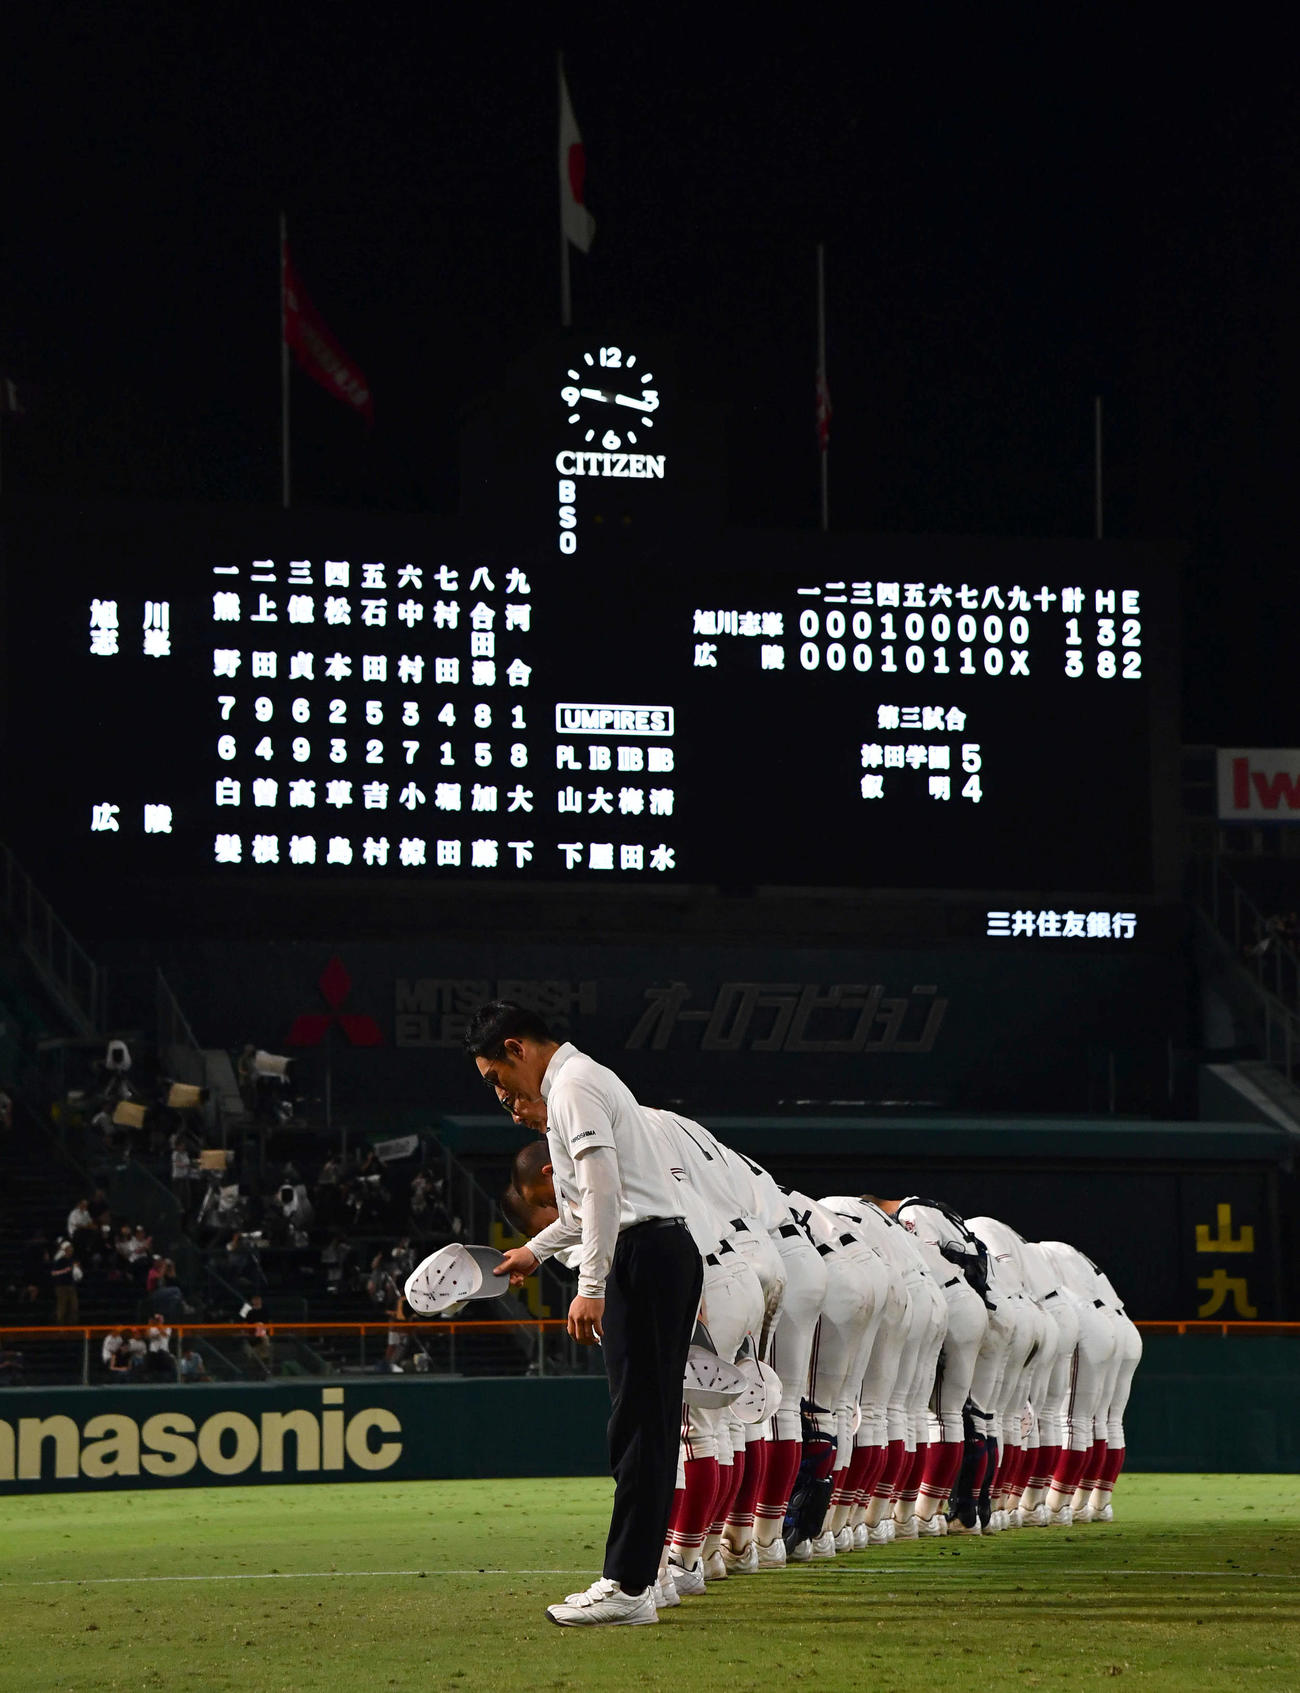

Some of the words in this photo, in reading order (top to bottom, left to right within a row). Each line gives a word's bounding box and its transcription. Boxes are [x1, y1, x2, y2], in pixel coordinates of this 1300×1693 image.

[600, 347, 621, 368] 12
[561, 387, 580, 407] 9
[602, 430, 621, 450] 6
[556, 451, 666, 478] CITIZEN
[559, 480, 576, 503] B
[559, 506, 576, 528] S
[560, 531, 576, 554] O
[218, 696, 235, 720] 7
[255, 697, 273, 722] 9
[292, 698, 310, 723] 6
[329, 699, 346, 723] 2
[366, 701, 383, 725] 5
[402, 702, 419, 726] 3
[438, 703, 456, 726] 4
[474, 704, 491, 728] 8
[512, 705, 526, 728] 1
[564, 709, 666, 731] UMPIRES
[877, 705, 966, 731] 第三試合
[218, 735, 236, 760] 6
[255, 737, 273, 760] 4
[292, 737, 310, 762] 9
[330, 739, 347, 763] 3
[366, 739, 383, 763] 2
[403, 741, 419, 764] 7
[440, 742, 455, 765] 1
[475, 743, 492, 766] 5
[511, 743, 528, 767] 8
[557, 745, 582, 769] PL
[962, 744, 981, 773] 5
[962, 775, 982, 803] 4
[987, 911, 1136, 938] 三井住友銀行
[624, 980, 949, 1052] オーロラビジョン
